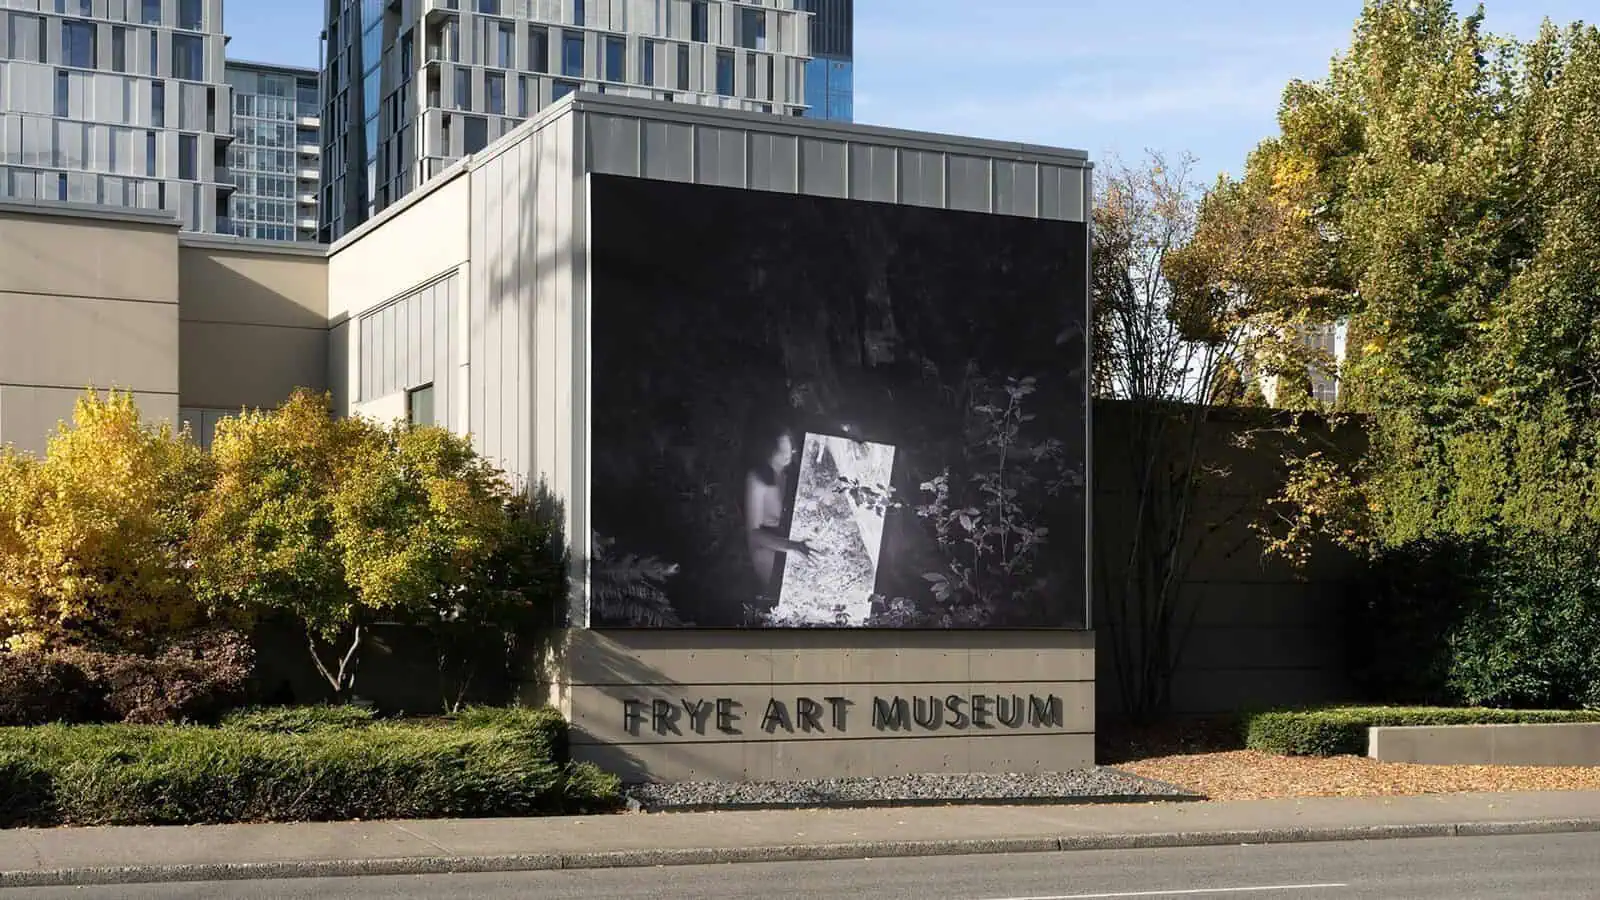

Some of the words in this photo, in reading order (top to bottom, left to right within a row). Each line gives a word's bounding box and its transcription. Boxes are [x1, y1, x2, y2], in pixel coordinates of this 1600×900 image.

[623, 698, 735, 733] FRYE
[760, 696, 846, 731] ART
[872, 694, 1058, 728] MUSEUM
